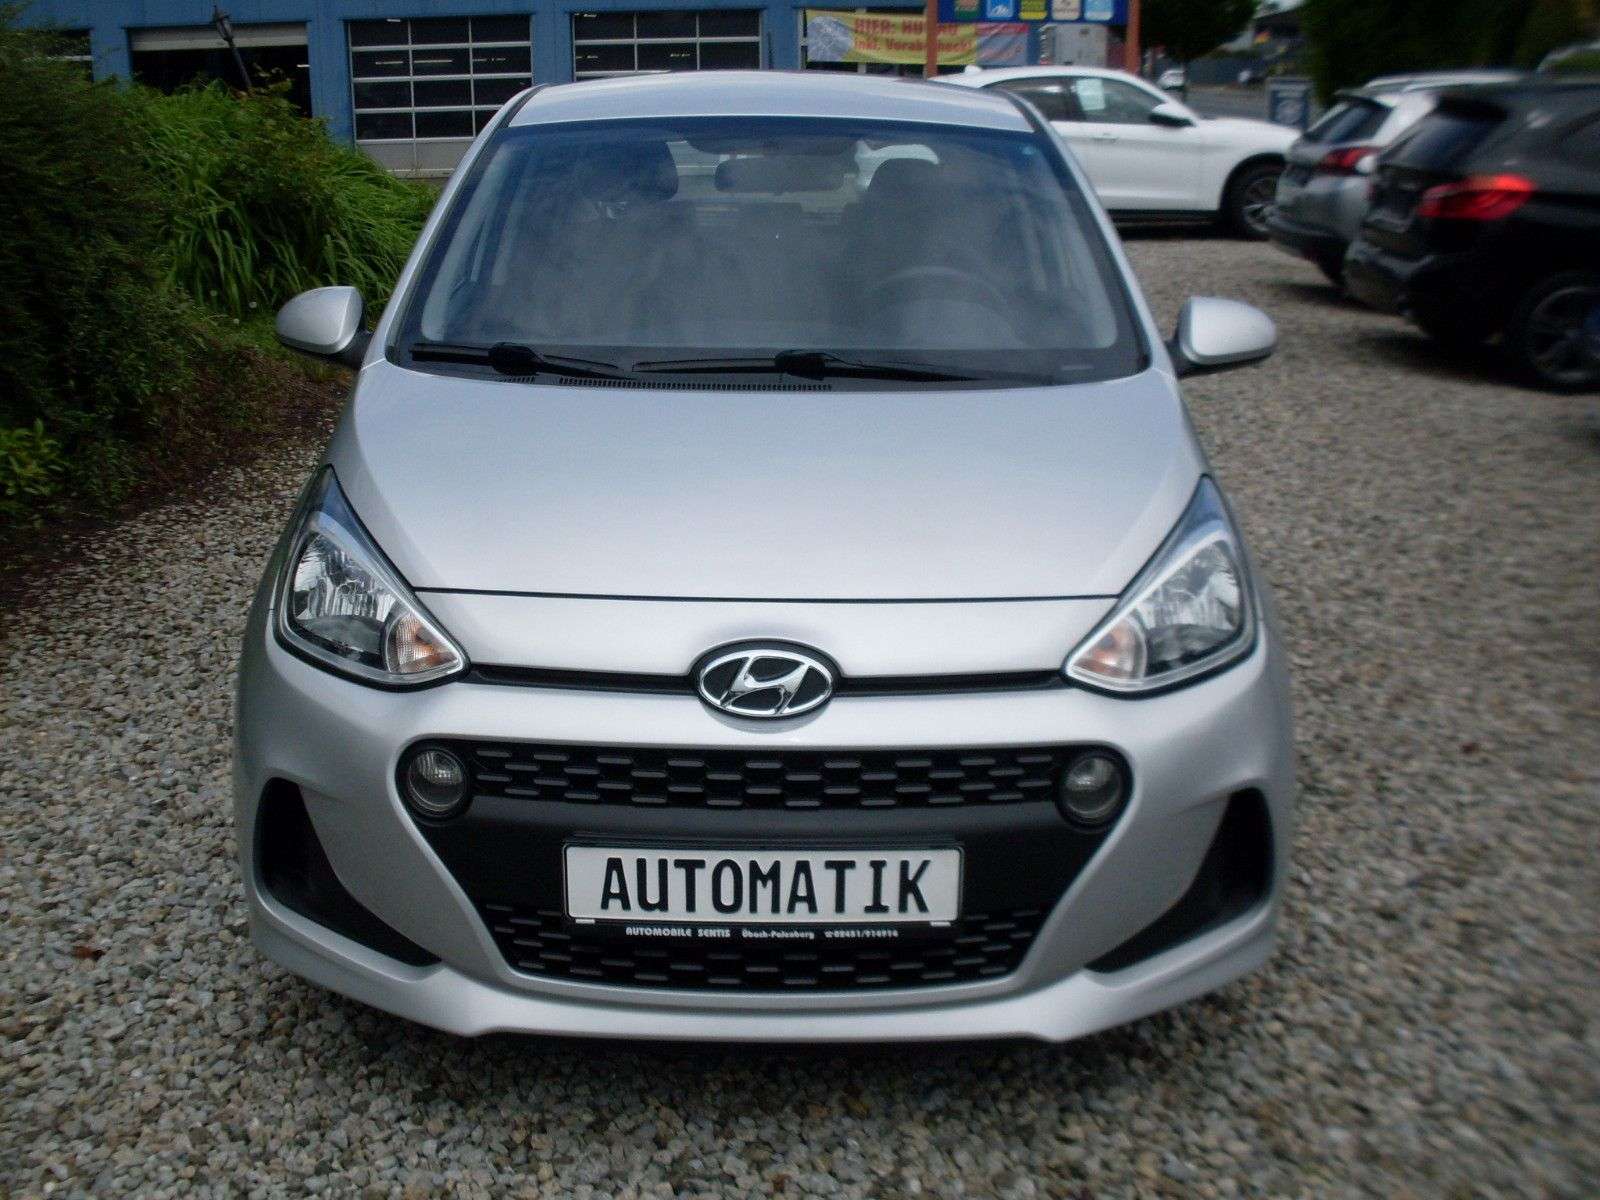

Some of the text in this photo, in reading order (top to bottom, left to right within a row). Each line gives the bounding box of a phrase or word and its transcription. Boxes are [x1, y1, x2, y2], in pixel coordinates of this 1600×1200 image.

[600, 856, 932, 914] AUTOMATIK
[625, 926, 692, 937] AUTOMOBILE
[697, 928, 731, 938] SENTIS
